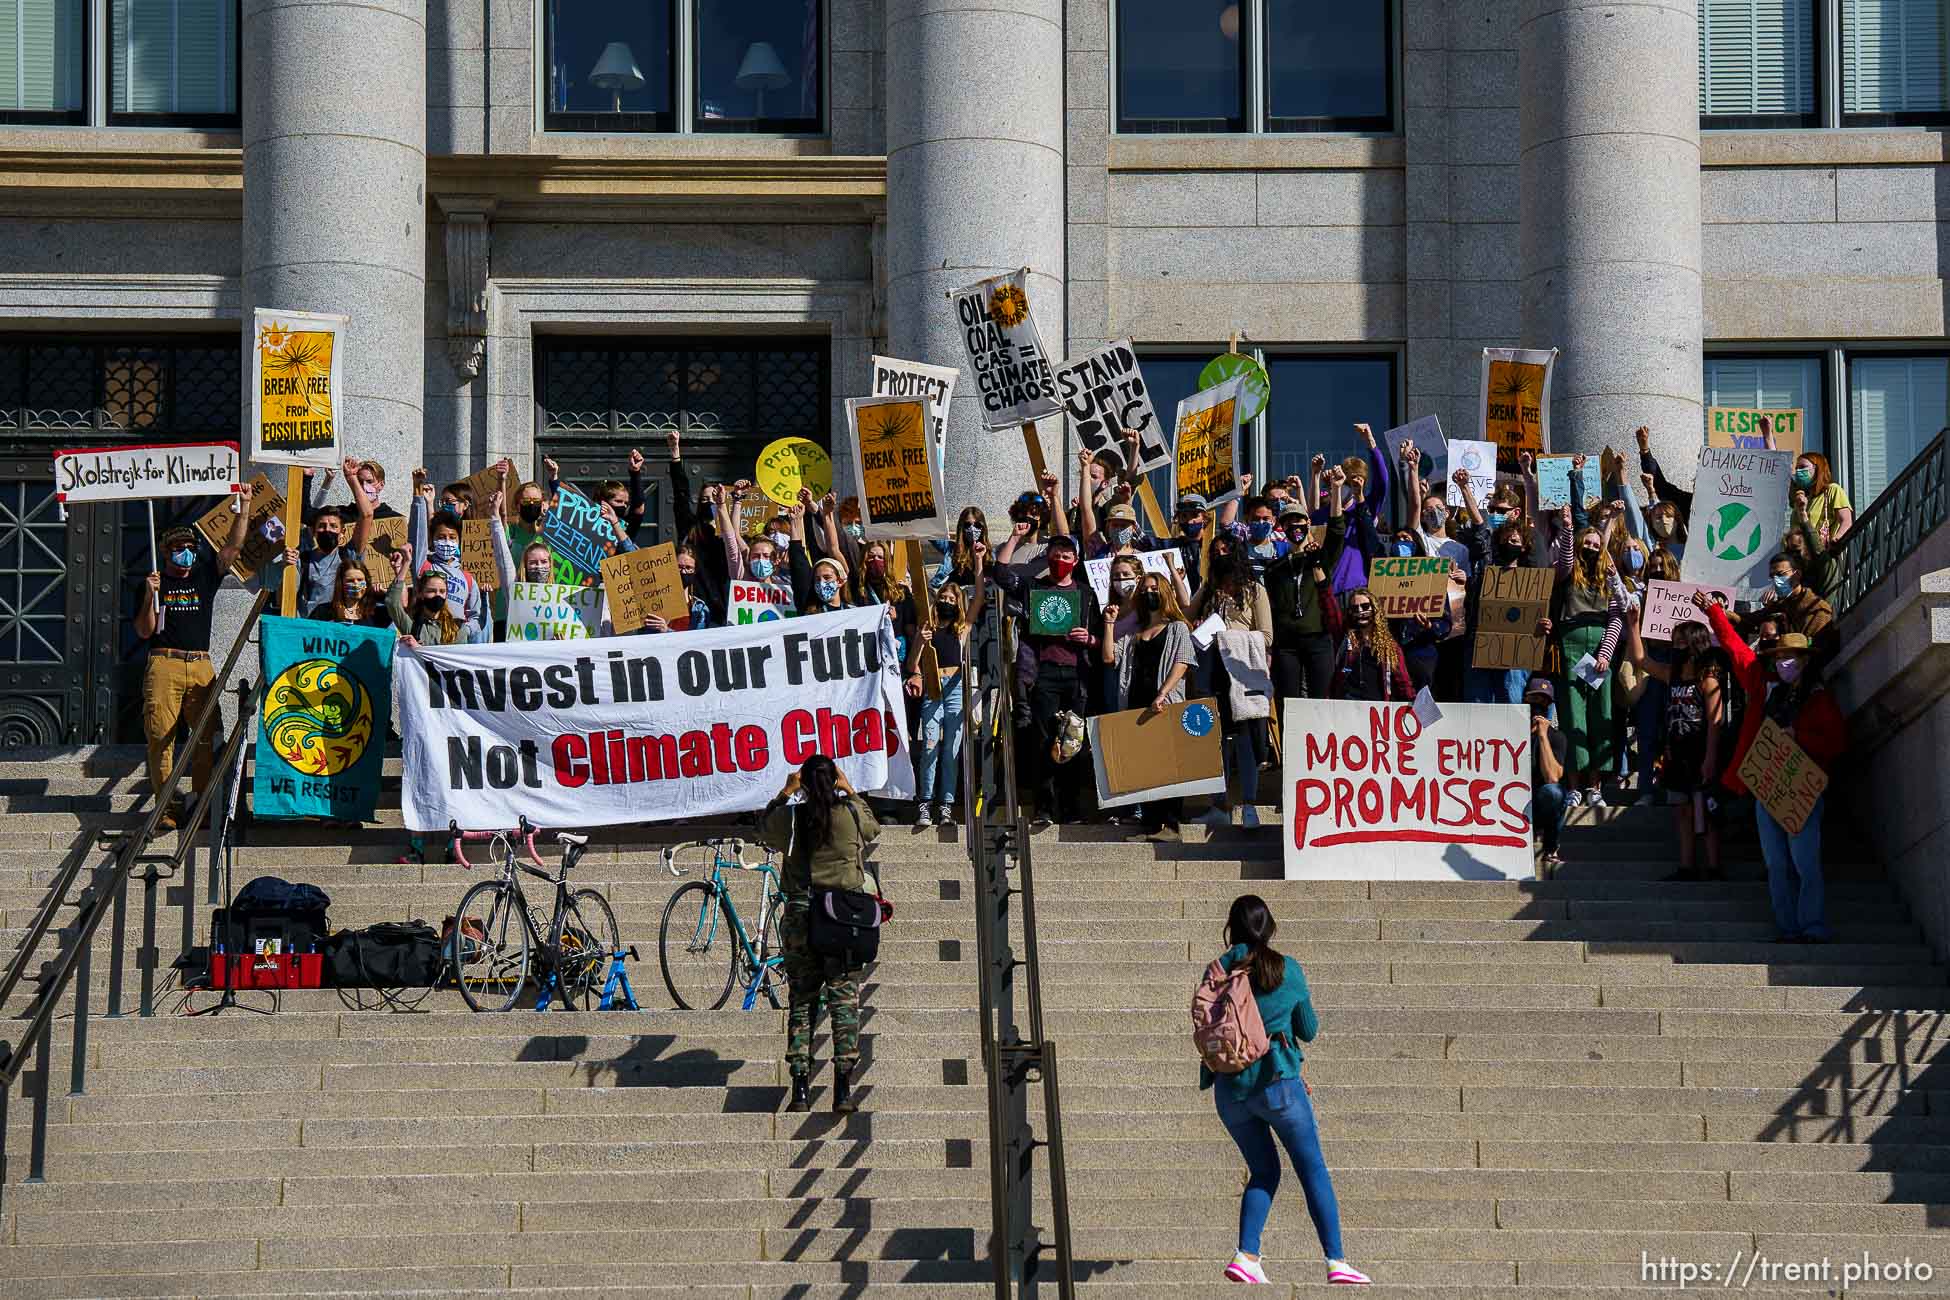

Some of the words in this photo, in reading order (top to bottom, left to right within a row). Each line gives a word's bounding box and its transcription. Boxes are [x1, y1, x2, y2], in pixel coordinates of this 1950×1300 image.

[959, 294, 992, 326] OIL
[978, 358, 1050, 393] CLIMATE
[1057, 346, 1134, 399] STAND
[264, 376, 299, 396] BREAK
[306, 376, 329, 395] FREE
[877, 366, 949, 407] PROTECT
[984, 378, 1056, 412] CHAOS
[1065, 384, 1114, 421] UP
[1117, 377, 1145, 402] TO
[285, 405, 310, 417] FROM
[1520, 406, 1539, 424] FREE
[1714, 411, 1797, 433] RESPCT
[263, 422, 300, 442] FOSSIL
[300, 420, 332, 441] FUELS
[1076, 400, 1154, 452] BIG
[864, 449, 896, 471] BREAK
[902, 447, 926, 466] FREE
[1179, 444, 1208, 466] BREAK
[1213, 432, 1232, 452] FREE
[1702, 448, 1757, 471] CHANGE
[1758, 457, 1780, 476] THE
[61, 455, 142, 492] Skolstrejk
[143, 457, 165, 481] för
[166, 453, 237, 484] Klimatet
[780, 464, 810, 478] our
[886, 477, 909, 490] FROM
[1196, 463, 1215, 479] FROM
[771, 481, 824, 501] Eah
[869, 496, 902, 517] FOSSIL
[902, 491, 933, 513] FUELS
[546, 510, 609, 570] DEFEND
[463, 562, 493, 571] HARRY
[606, 559, 630, 579] We
[636, 550, 672, 572] cannot
[1374, 558, 1448, 577] SCIENCE
[617, 575, 633, 594] eat
[640, 571, 656, 586] coal
[643, 584, 672, 600] cannot
[733, 585, 791, 606] DENIAL
[1398, 580, 1415, 589] NOT
[1482, 566, 1548, 601] DENIAL
[1653, 585, 1691, 604] There
[513, 583, 605, 609] RESPECT
[534, 605, 583, 622] YOUR
[624, 602, 646, 620] drink
[1671, 605, 1693, 619] NO
[302, 636, 350, 658] WIND
[1472, 634, 1542, 668] POLICY
[426, 655, 600, 713] Invest
[606, 650, 665, 704] in
[676, 643, 773, 696] our
[1369, 705, 1422, 742] NO
[448, 736, 545, 791] Not
[551, 722, 770, 789] Climate
[1306, 732, 1418, 776] MORE
[1437, 738, 1528, 776] EMPTY
[1742, 725, 1779, 788] STOP
[270, 778, 295, 796] WE
[302, 781, 360, 803] RESIST
[1783, 769, 1825, 834] DYING
[1294, 776, 1531, 850] PROMISES
